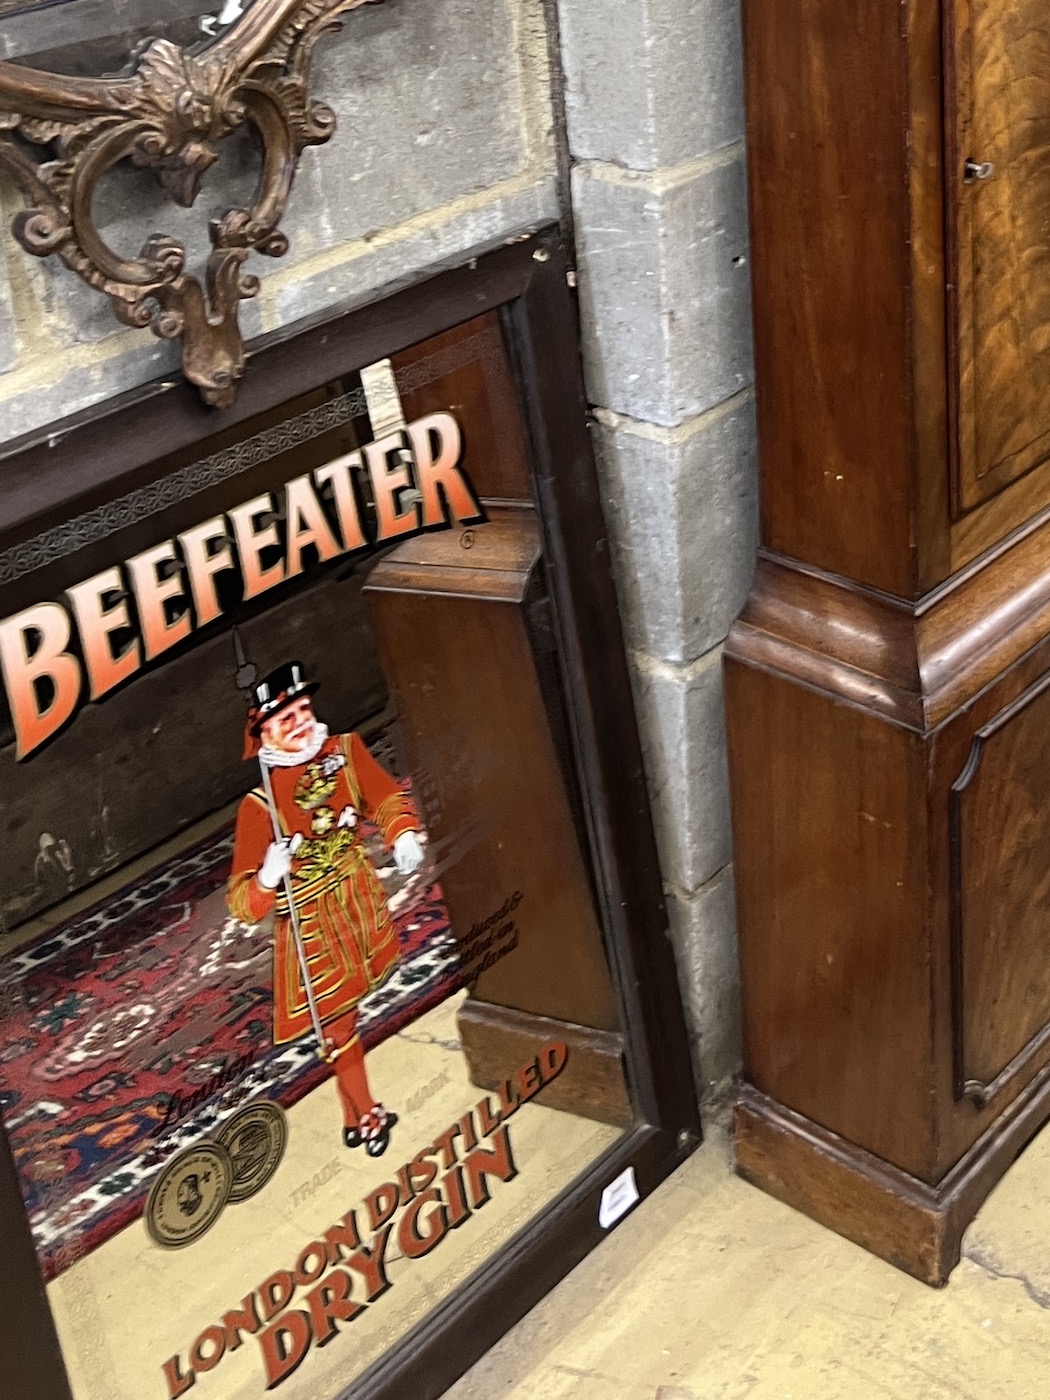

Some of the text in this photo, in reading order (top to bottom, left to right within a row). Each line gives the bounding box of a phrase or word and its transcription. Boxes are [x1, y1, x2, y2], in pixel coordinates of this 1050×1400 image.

[0, 411, 480, 761] BEEFEATER
[162, 1208, 361, 1398] LONDON
[364, 1041, 569, 1232] DISTILLED
[258, 1222, 396, 1390] DRY
[400, 1126, 519, 1260] GIN
